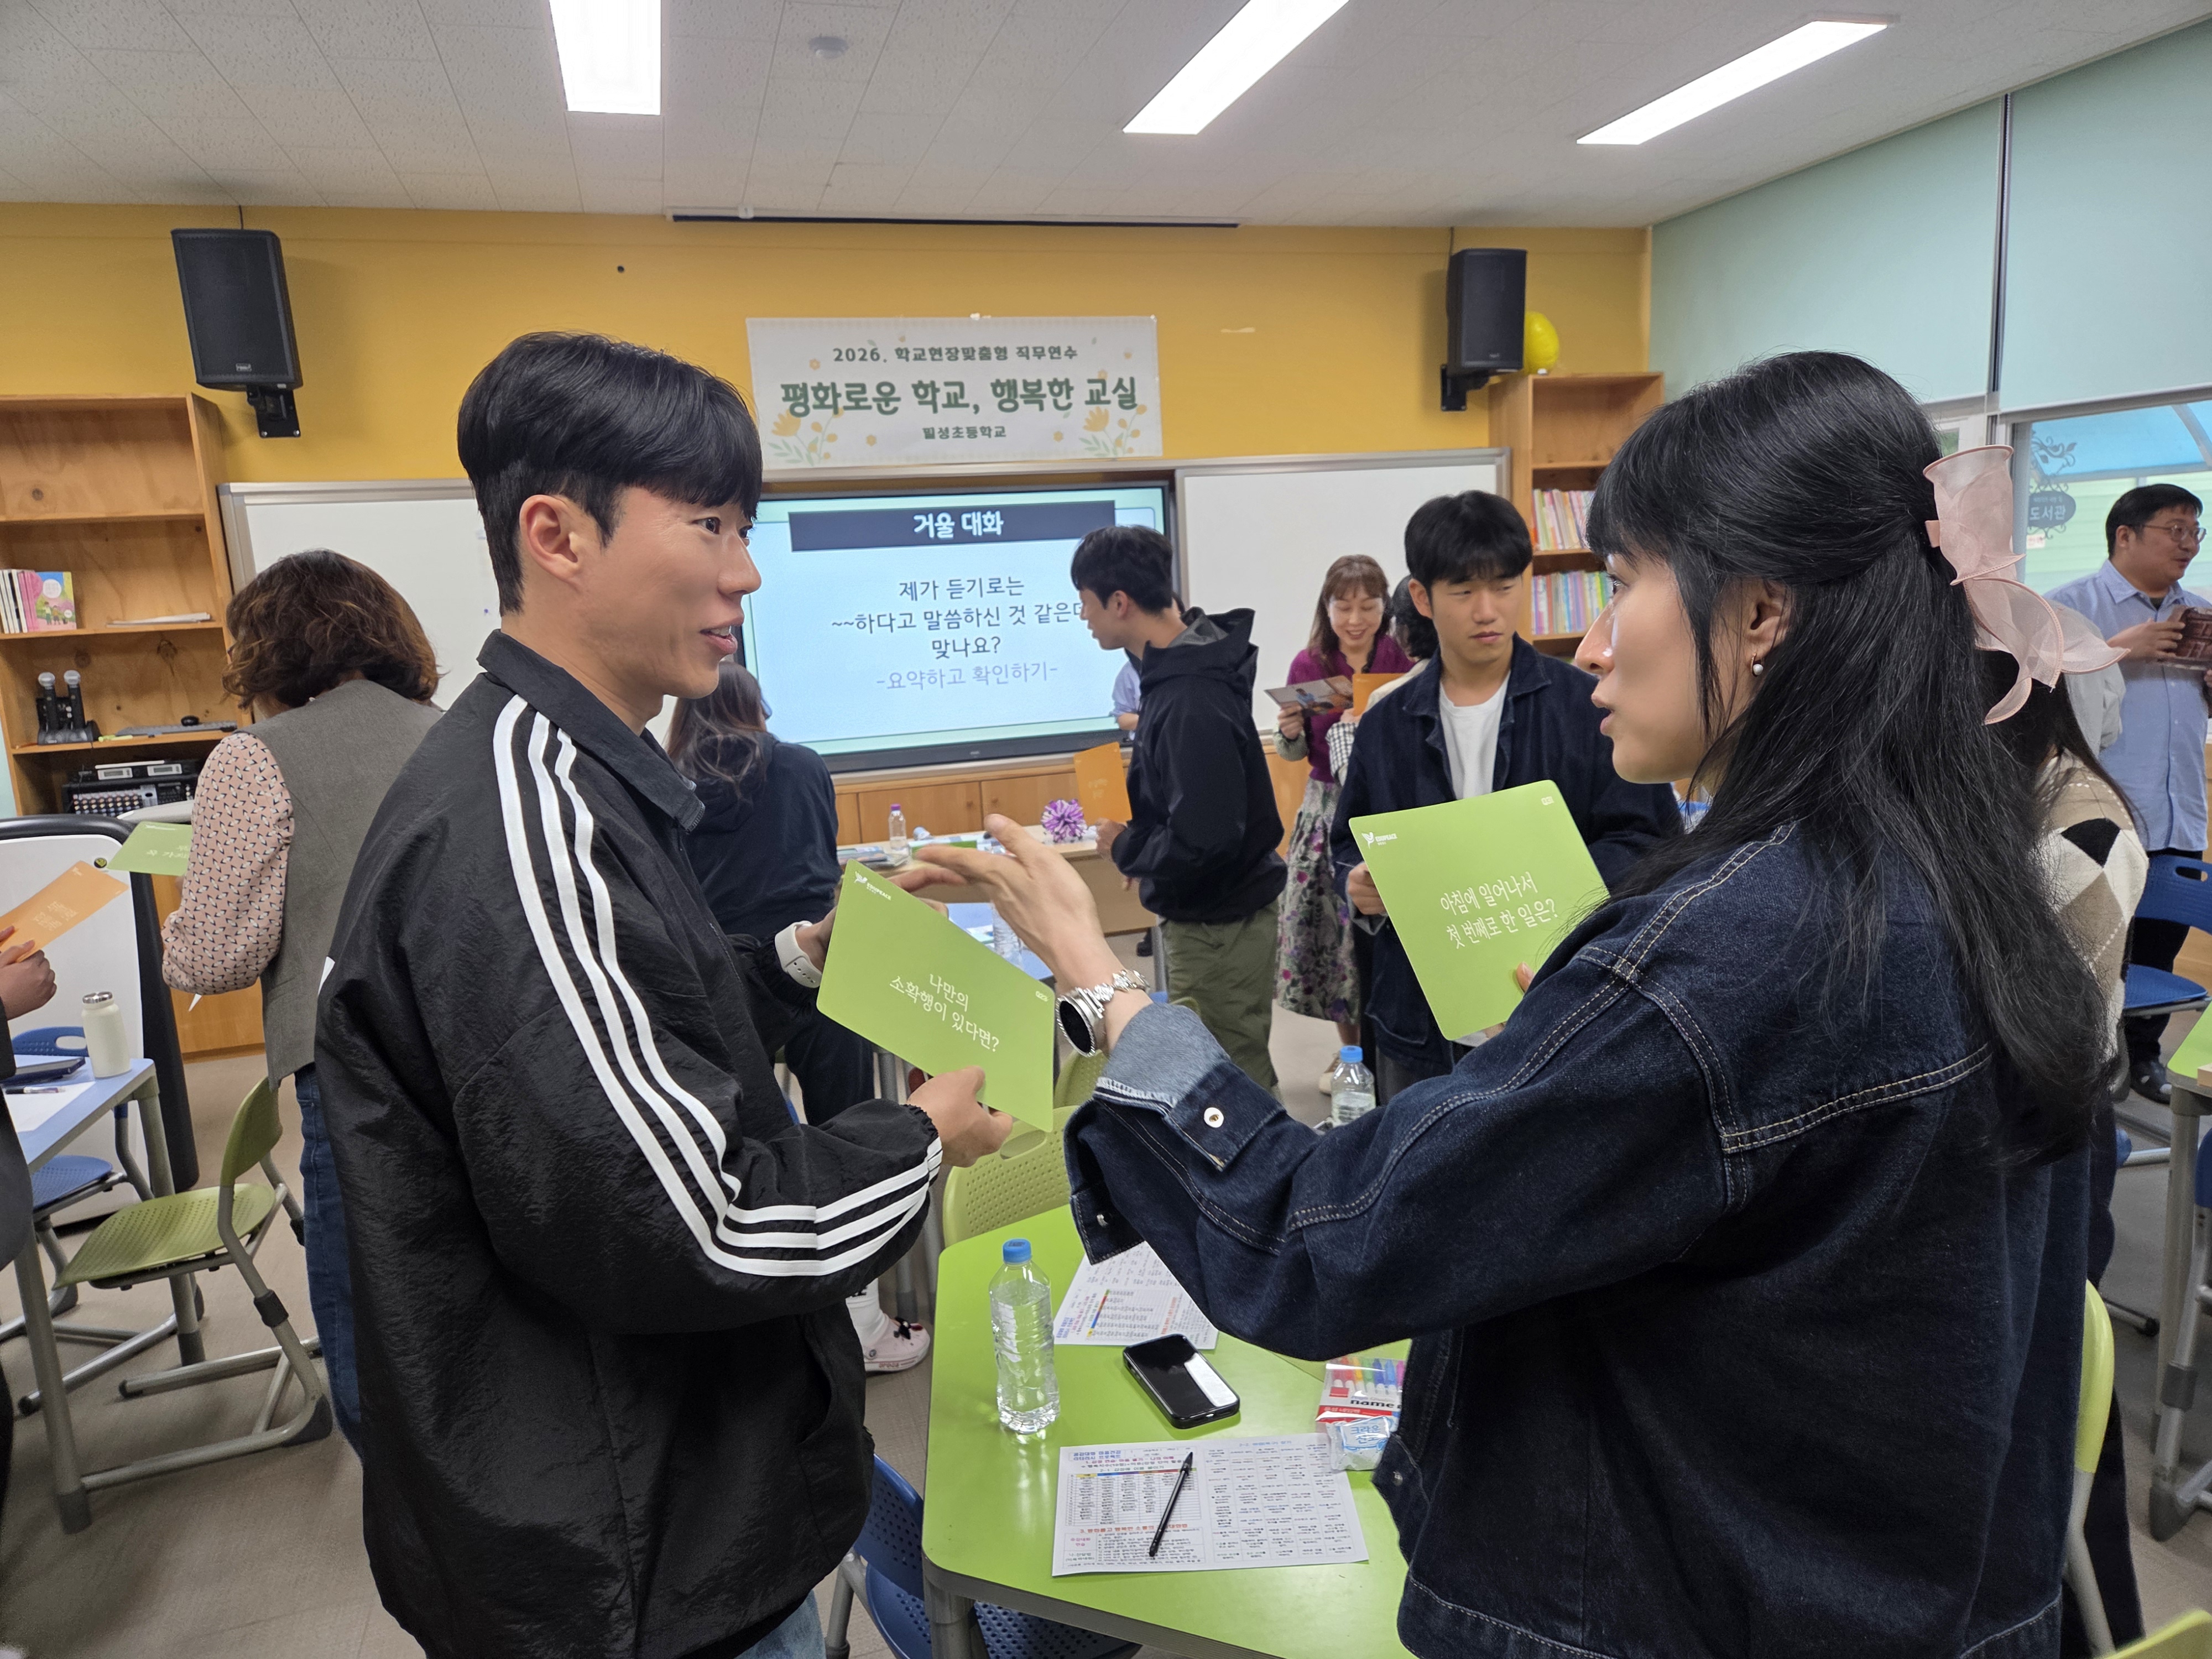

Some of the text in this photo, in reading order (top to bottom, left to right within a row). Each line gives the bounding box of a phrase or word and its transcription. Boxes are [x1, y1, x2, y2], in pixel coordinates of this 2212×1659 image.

[833, 346, 1078, 363] 2026. 학교현장맞춤형 직무연수
[780, 377, 1138, 418] 평화로운 학교, 행복한 교실
[914, 510, 1004, 539] 거울 대화
[2030, 504, 2066, 521] 도서관
[899, 576, 1025, 602] 제가 듣기로는
[832, 613, 917, 634] ~~하다고
[924, 606, 1000, 631] 말씀하신
[1009, 605, 1026, 625] 것
[932, 636, 1001, 660] 맞나요?
[877, 661, 1058, 691] -요약하고 확인하기-
[1375, 833, 1397, 842] EDUPEACE
[867, 883, 891, 901] EDUPEACE
[1440, 872, 1538, 916] 아침에 일어나서
[1446, 898, 1558, 950] 첫 번째로 한 일은?
[930, 973, 969, 1012] 나만의
[889, 976, 1000, 1052] 소확행이 있다면?
[1350, 1400, 1394, 1408] name
[1350, 1425, 1381, 1434] 크라운
